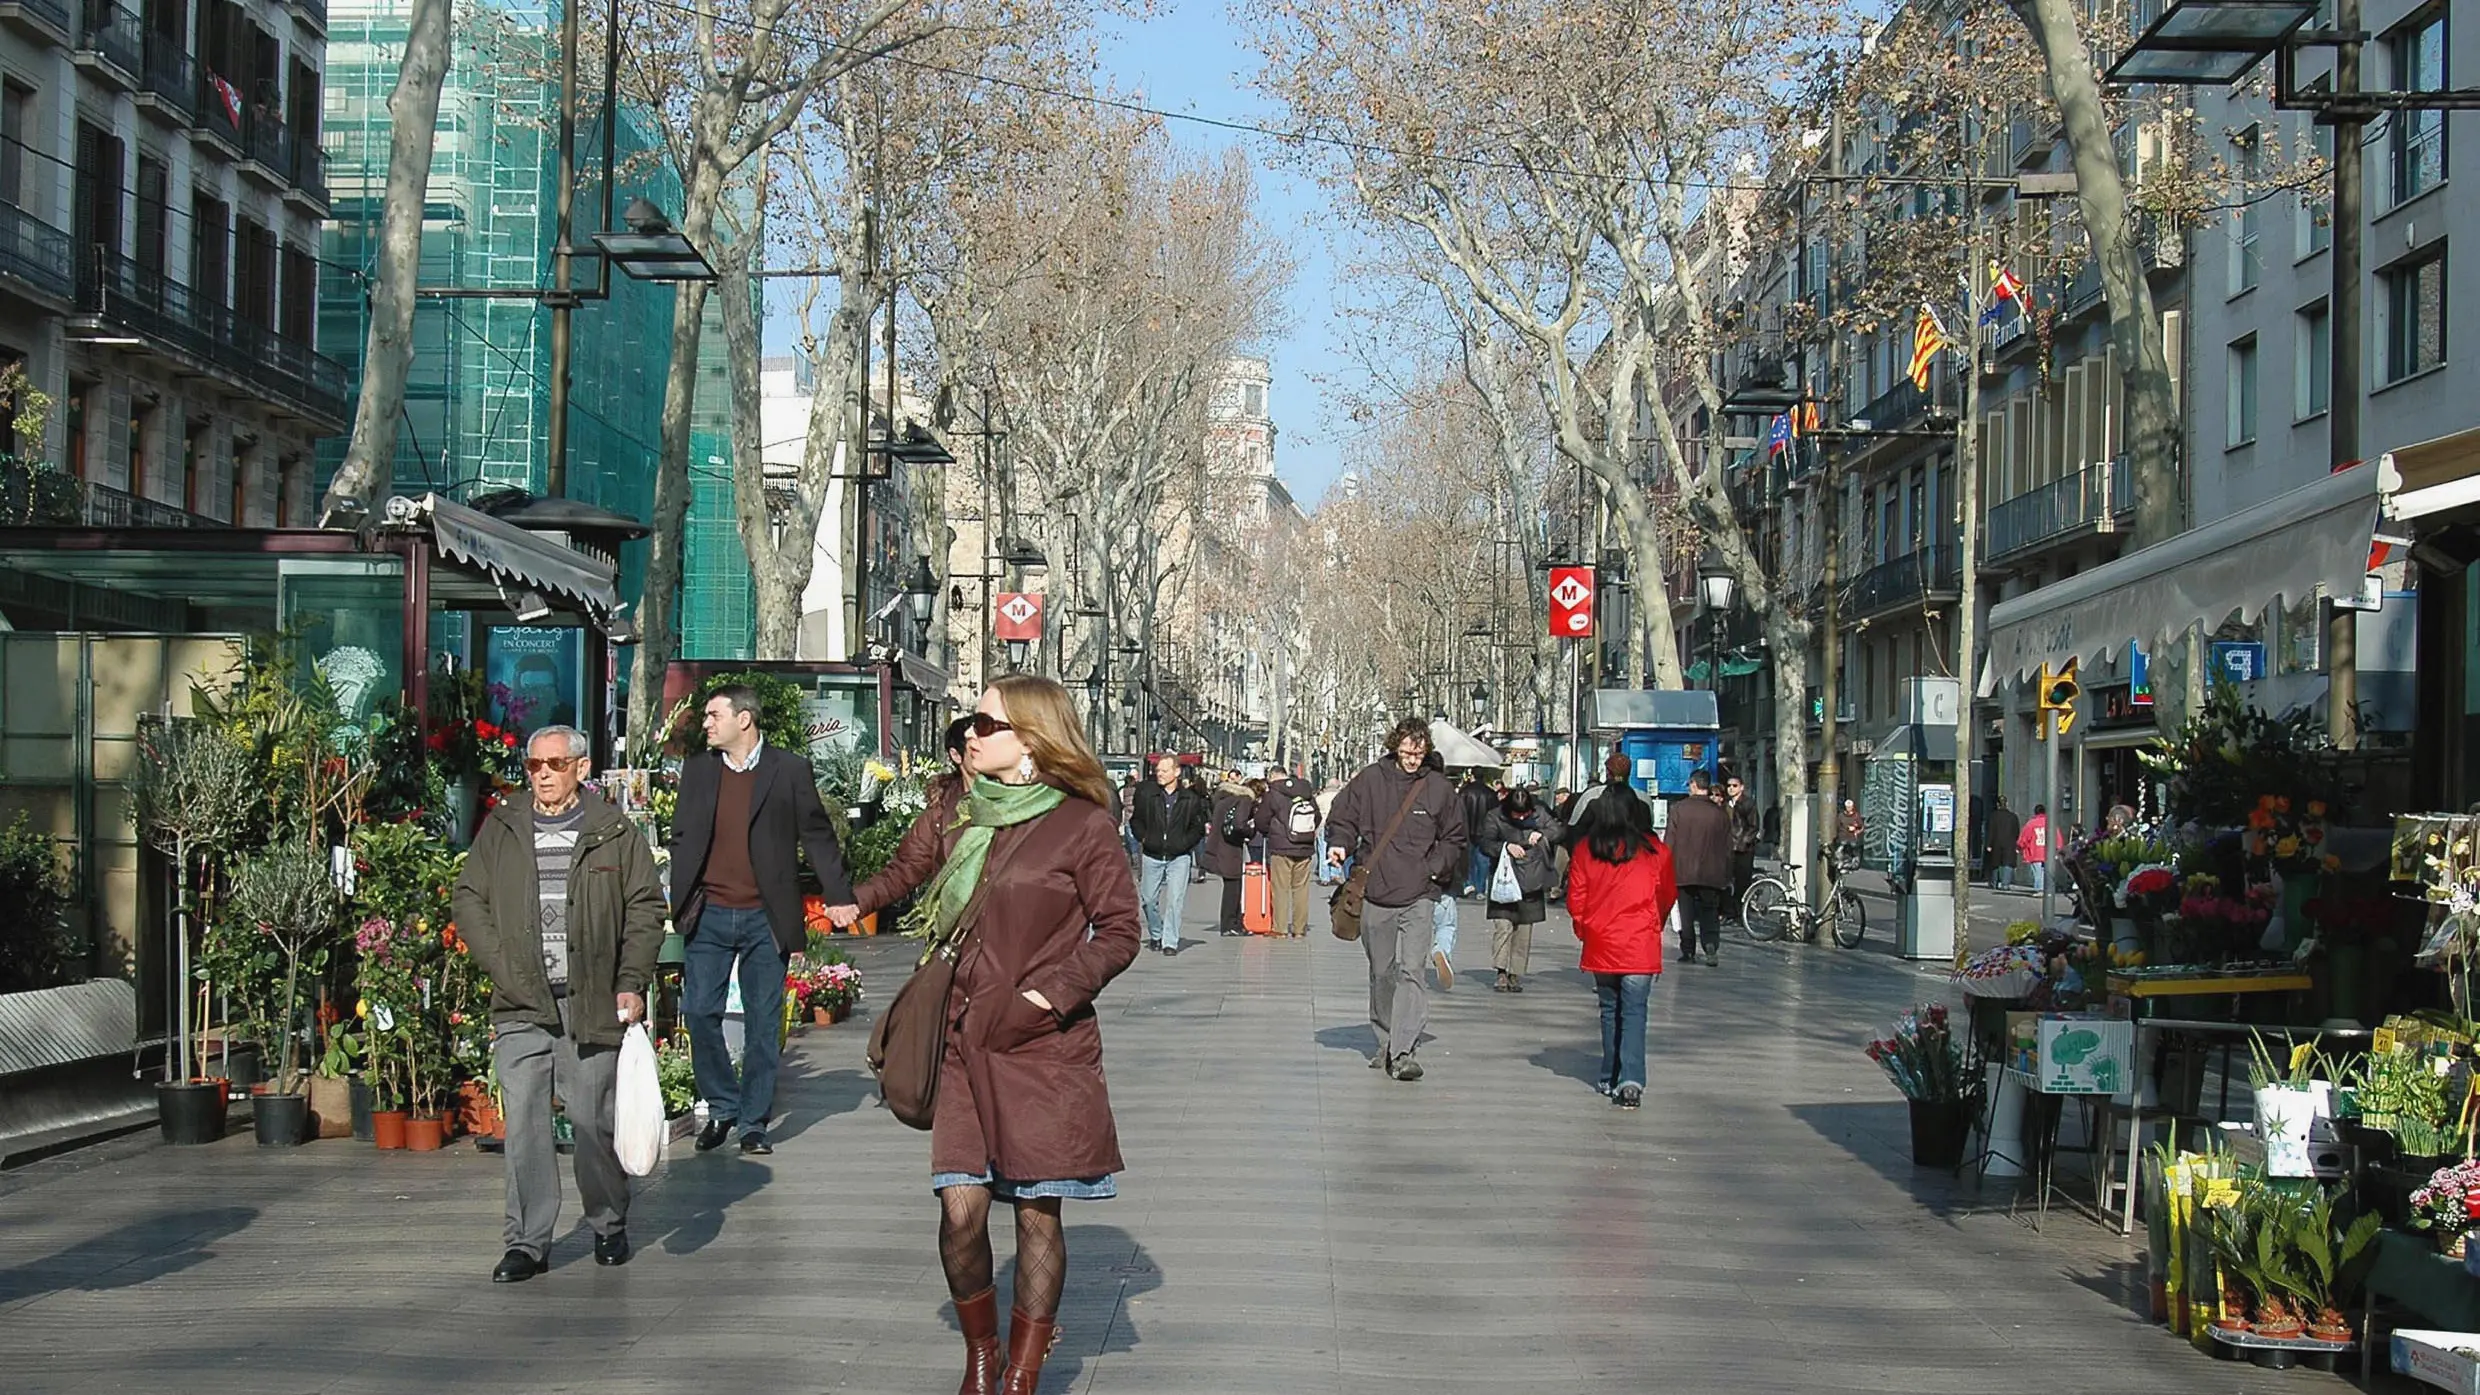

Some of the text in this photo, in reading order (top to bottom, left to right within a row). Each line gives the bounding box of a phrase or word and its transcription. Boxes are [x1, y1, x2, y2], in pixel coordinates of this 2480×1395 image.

[1562, 585, 1577, 600] M
[1012, 604, 1026, 617] M
[515, 639, 556, 648] CONCERT
[804, 717, 849, 738] aria
